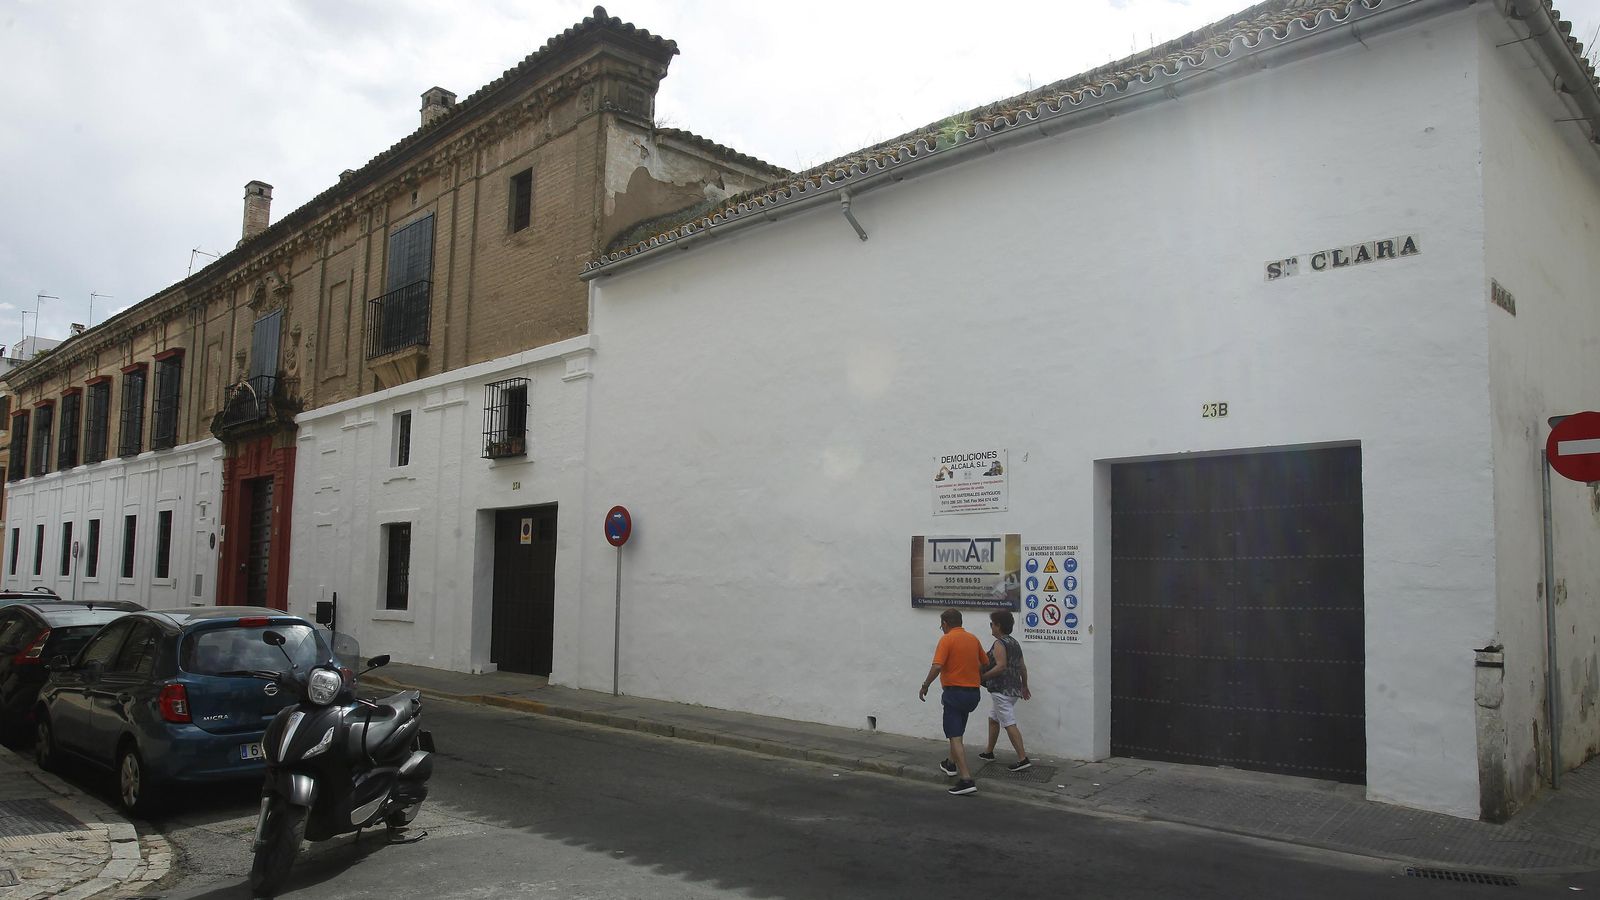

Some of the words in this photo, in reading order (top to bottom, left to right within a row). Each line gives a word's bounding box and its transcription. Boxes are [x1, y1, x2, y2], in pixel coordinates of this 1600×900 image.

[1311, 236, 1418, 271] CLARA
[1202, 402, 1228, 418] 23B
[942, 450, 997, 463] DEMOLICIONES
